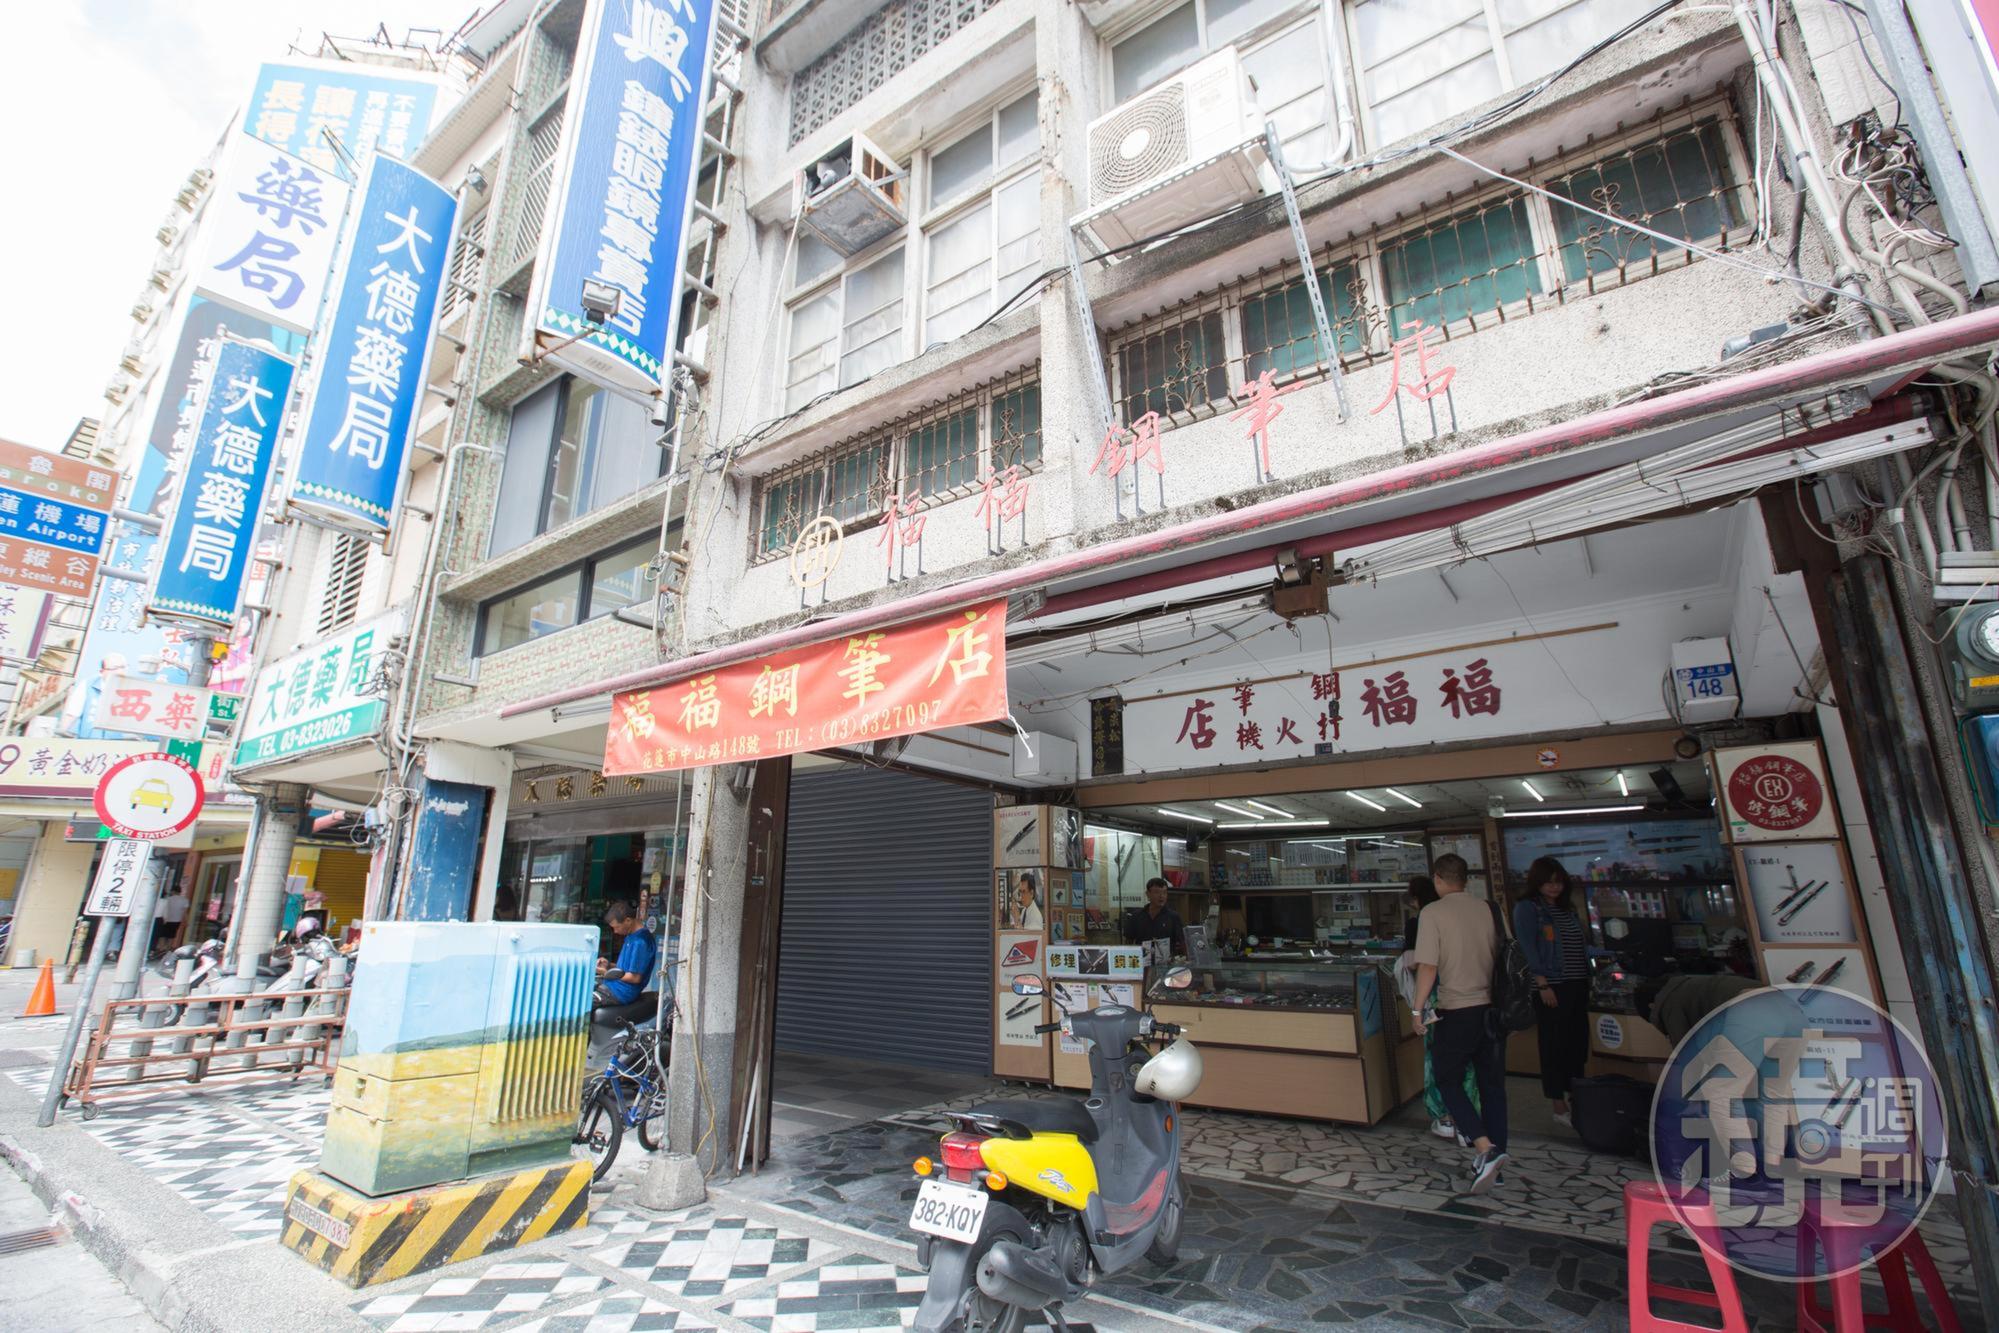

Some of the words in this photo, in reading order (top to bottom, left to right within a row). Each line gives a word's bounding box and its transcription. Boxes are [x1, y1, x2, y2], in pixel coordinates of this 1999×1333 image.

[214, 156, 328, 310] 藥局
[330, 206, 433, 471] 大德藥局
[179, 375, 274, 581] 大德藥局
[26, 522, 96, 546] Airport
[20, 567, 56, 584] Scenic
[60, 576, 86, 590] Area
[259, 628, 375, 727] 大德藥局
[620, 610, 993, 743] 福福鋼筆店
[1361, 657, 1502, 727] 福福
[1687, 678, 1723, 698] 148
[110, 689, 198, 730] 西藥
[258, 733, 277, 757] TEL
[281, 712, 352, 754] 03-8323026
[642, 736, 760, 769] 花蓮市中山路148號
[821, 699, 942, 743] (03)8327097
[1176, 699, 1218, 750] 店
[28, 747, 128, 777] 黃金奶
[112, 823, 133, 837] TAXI
[136, 827, 178, 840] STATION
[99, 841, 137, 912] 限停2輛
[1050, 953, 1076, 969] 修理
